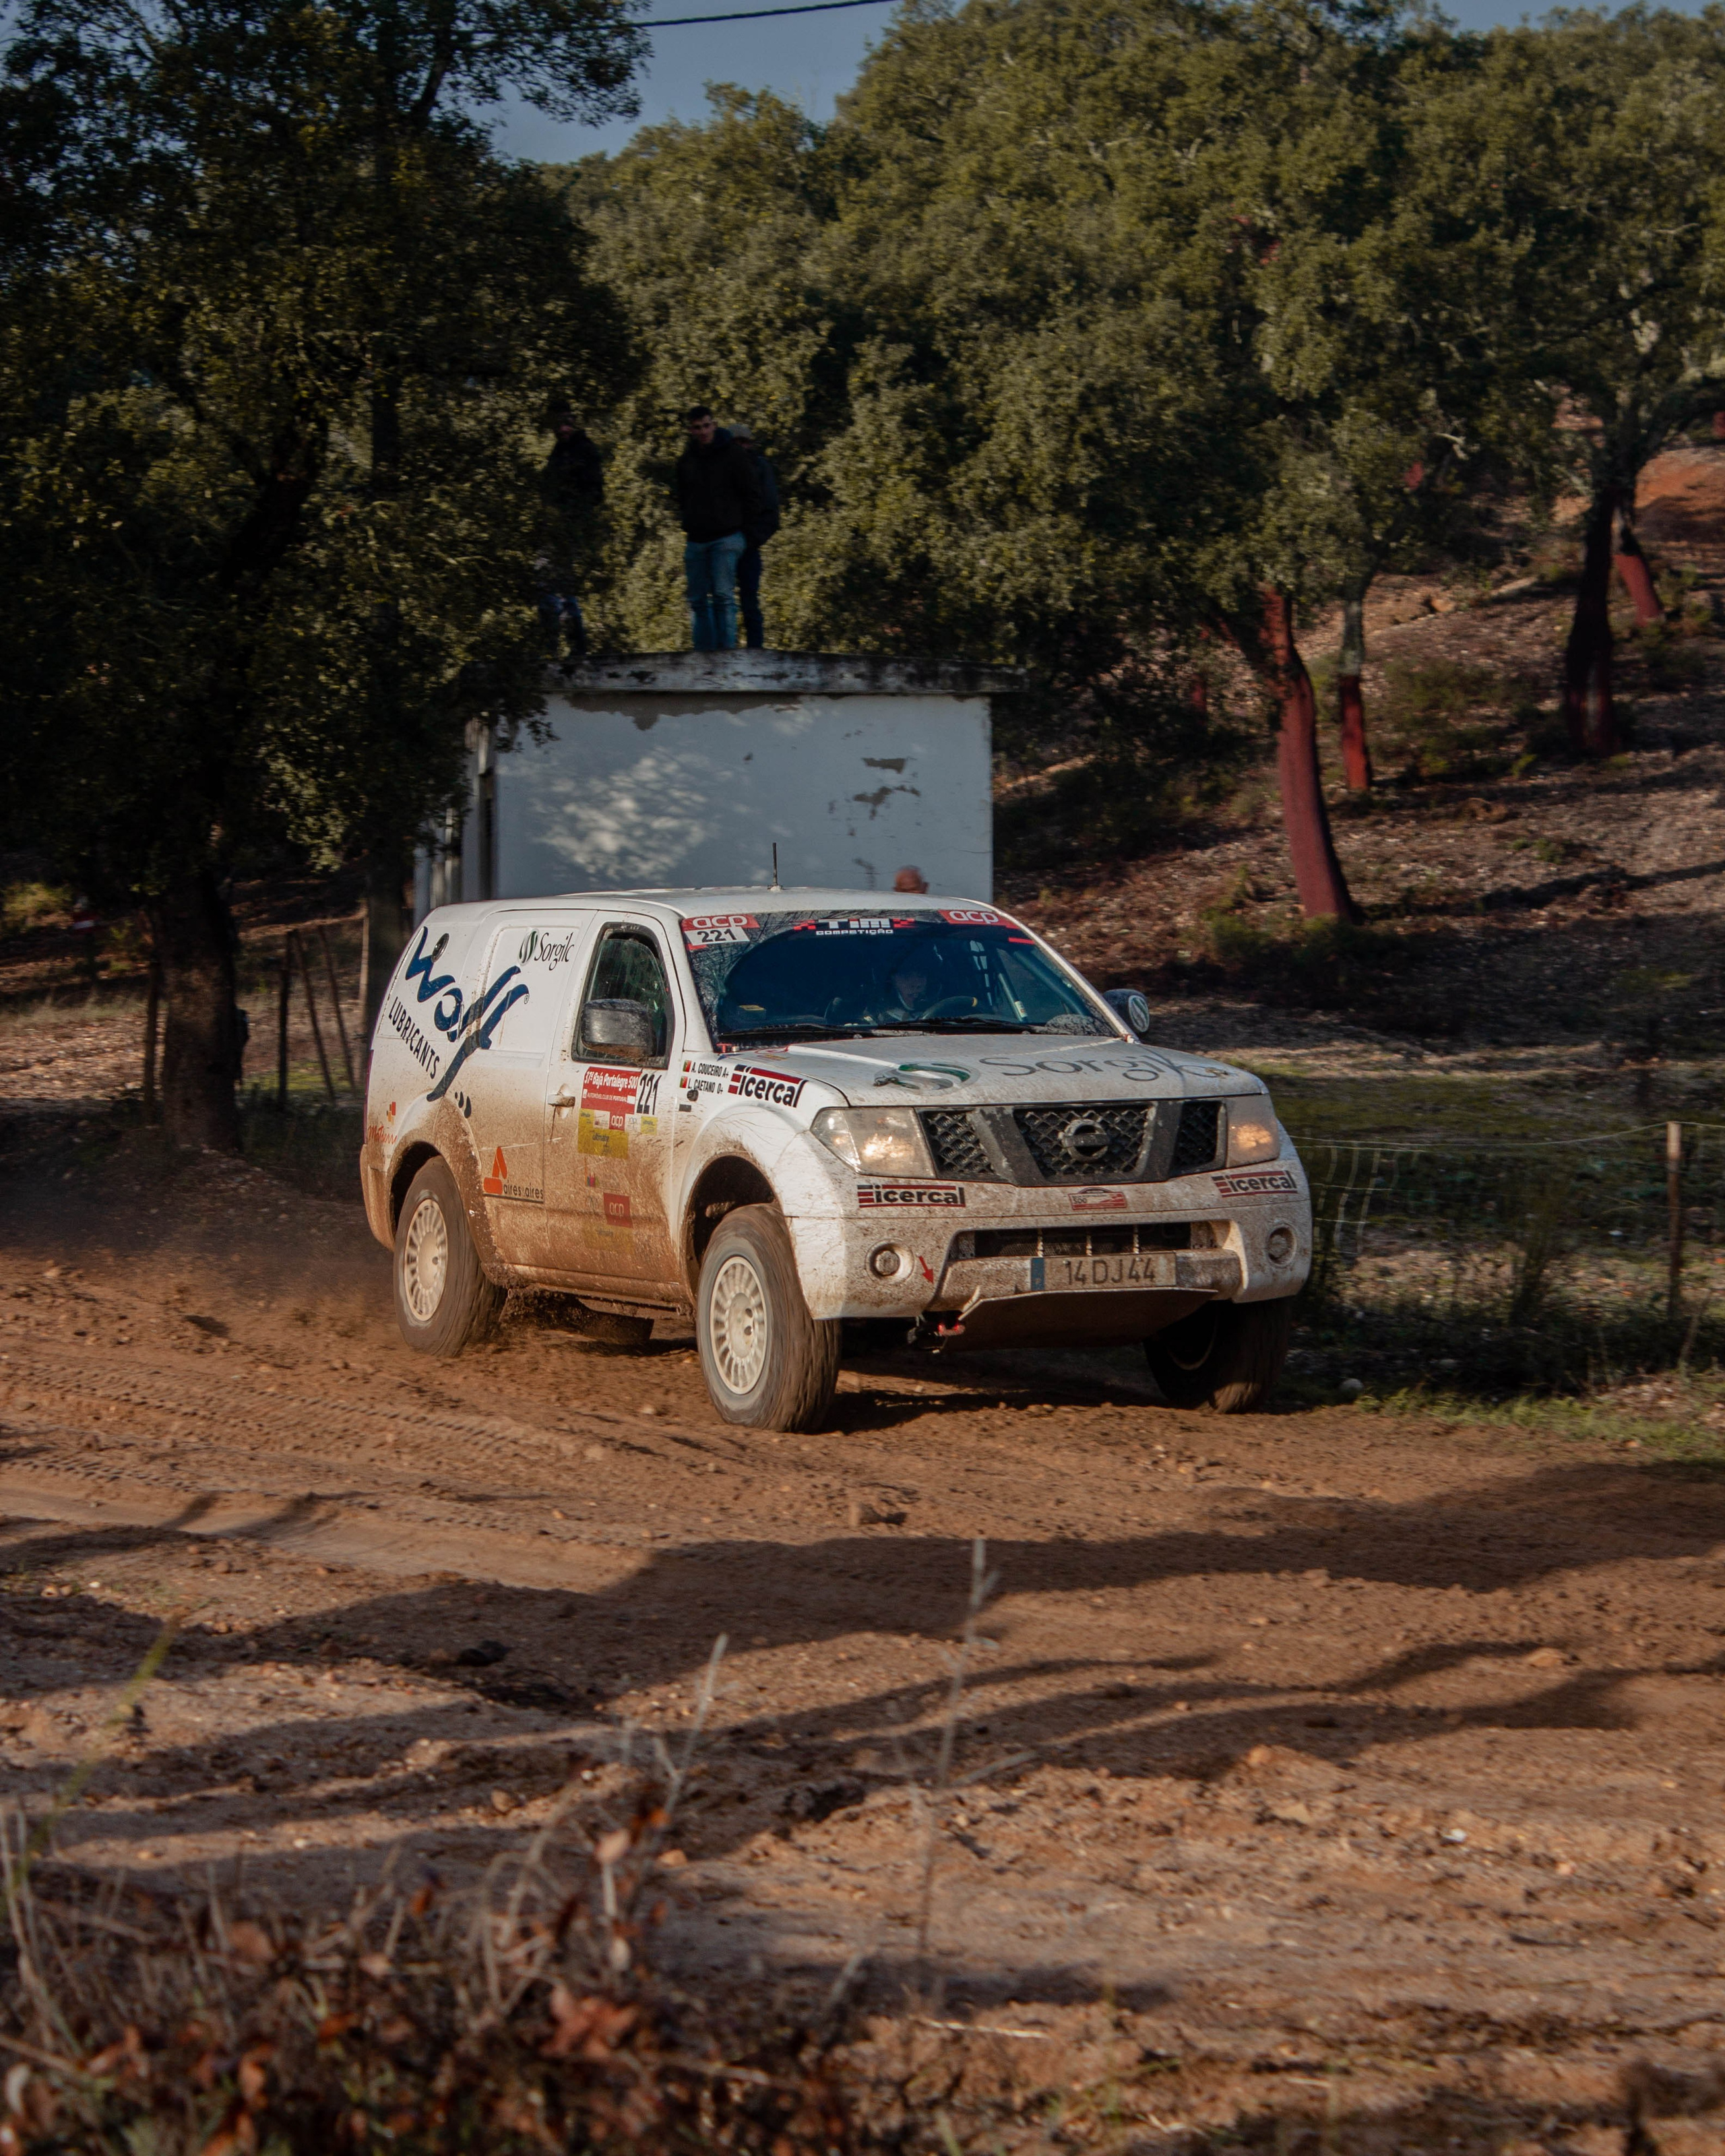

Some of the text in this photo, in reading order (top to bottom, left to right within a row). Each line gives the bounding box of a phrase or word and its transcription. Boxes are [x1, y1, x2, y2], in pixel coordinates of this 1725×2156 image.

[692, 916, 748, 928] acp
[949, 911, 999, 924] acp
[697, 928, 737, 943] 221
[388, 996, 440, 1079] LUBRICANTS
[691, 1062, 697, 1073] A.
[697, 1063, 723, 1077] COUCEIRO
[636, 1073, 662, 1116] 221
[738, 1066, 809, 1108] icercal
[611, 1115, 624, 1129] acp
[503, 1179, 544, 1199] aires aires
[1224, 1170, 1297, 1192] icercal
[875, 1184, 966, 1205] icercal
